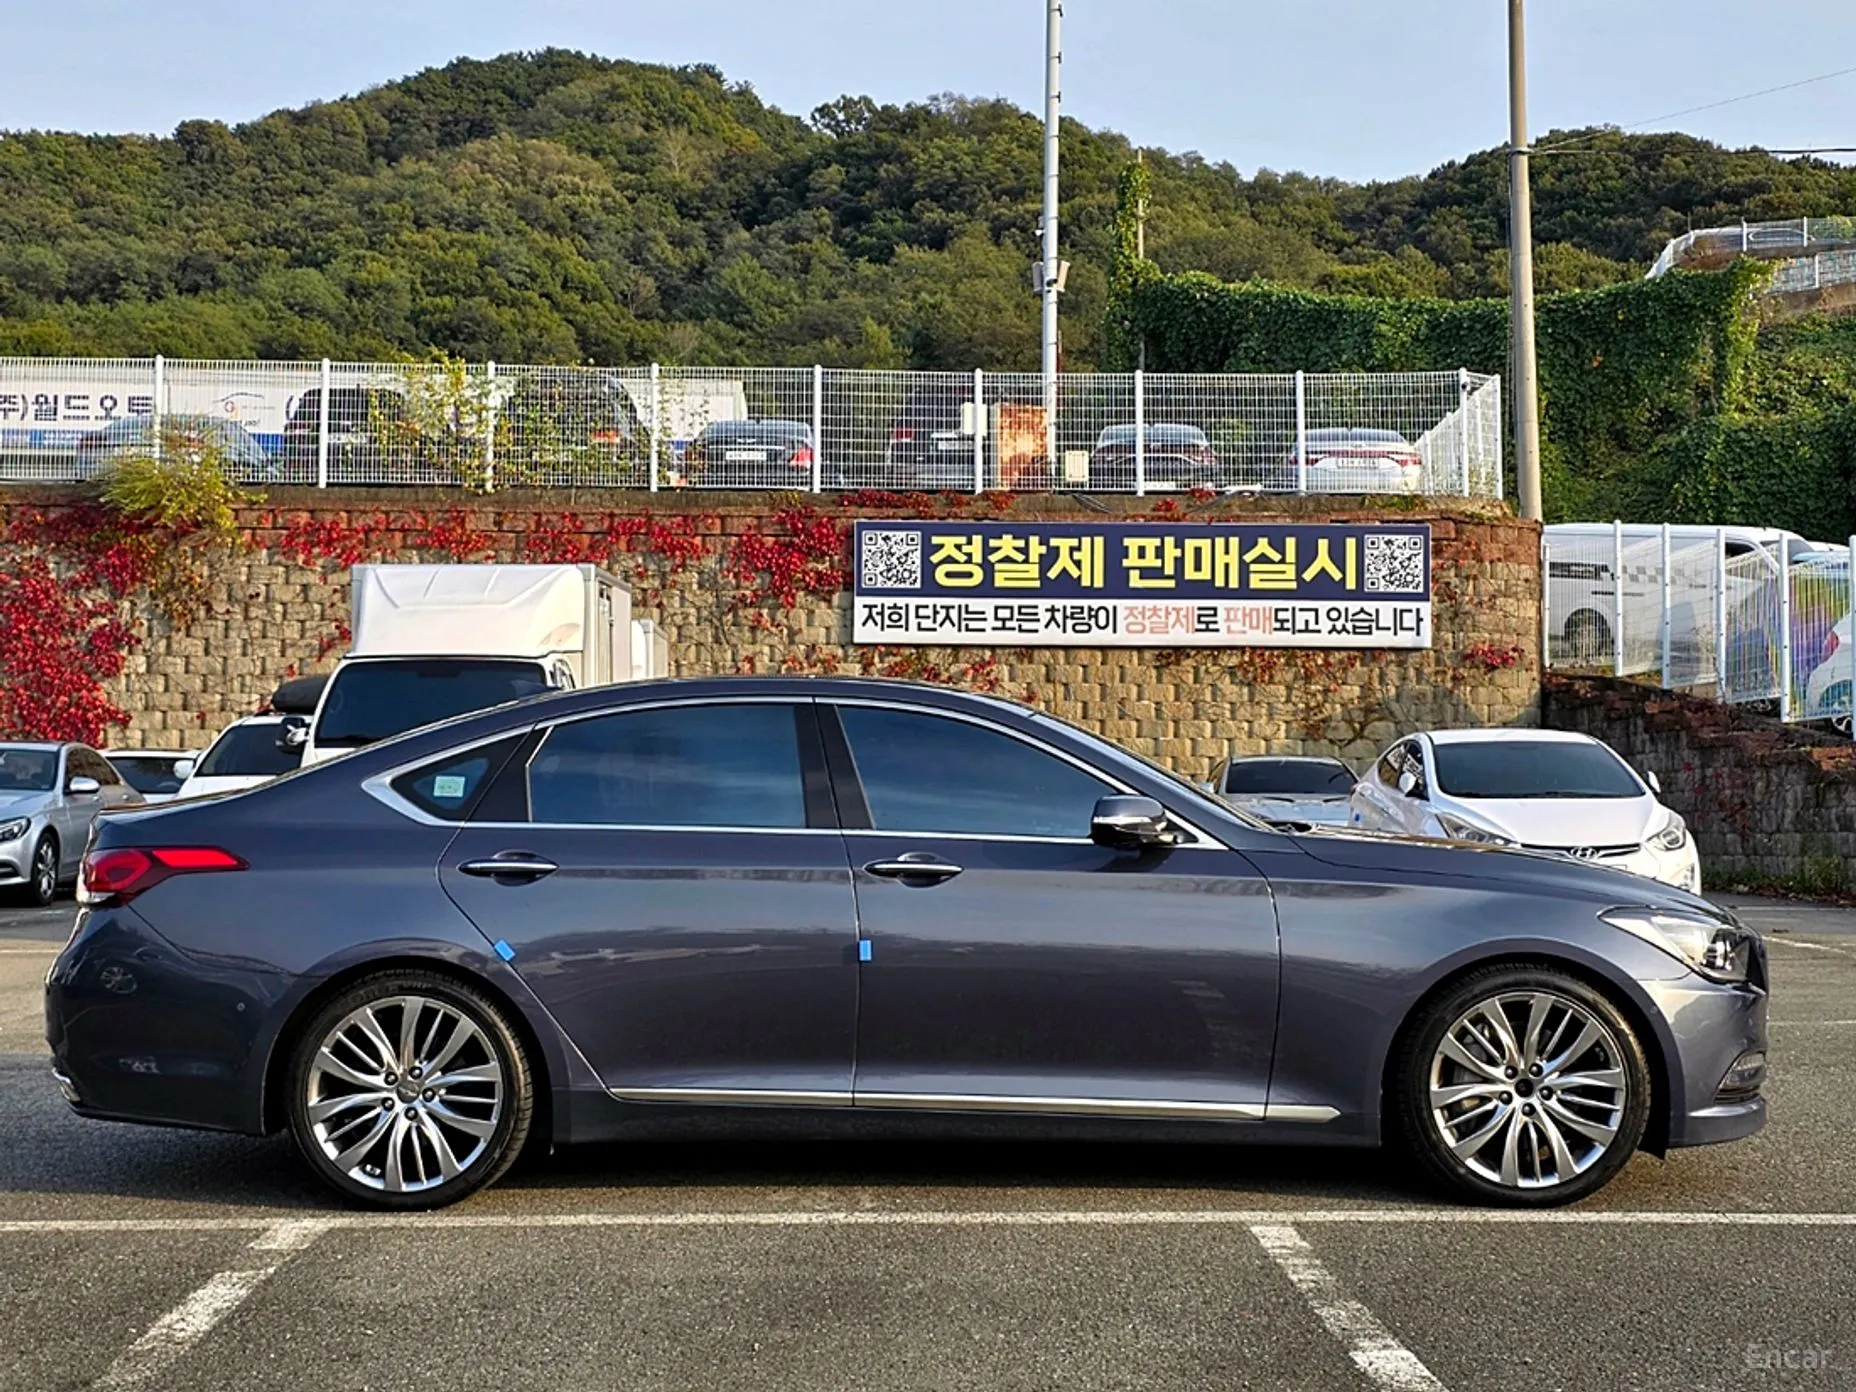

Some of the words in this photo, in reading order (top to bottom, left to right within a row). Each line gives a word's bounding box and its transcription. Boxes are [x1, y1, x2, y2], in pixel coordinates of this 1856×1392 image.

[929, 534, 1104, 589] 정찰제
[1121, 536, 1358, 591] 판매실시
[861, 603, 909, 632] 저희
[914, 603, 988, 633] 단지는
[991, 604, 1040, 634] 모든
[1044, 604, 1117, 634] 차량이
[1123, 605, 1220, 635] 정찰제로
[1224, 606, 1321, 635] 판매되고
[1325, 606, 1424, 636] 있습니다
